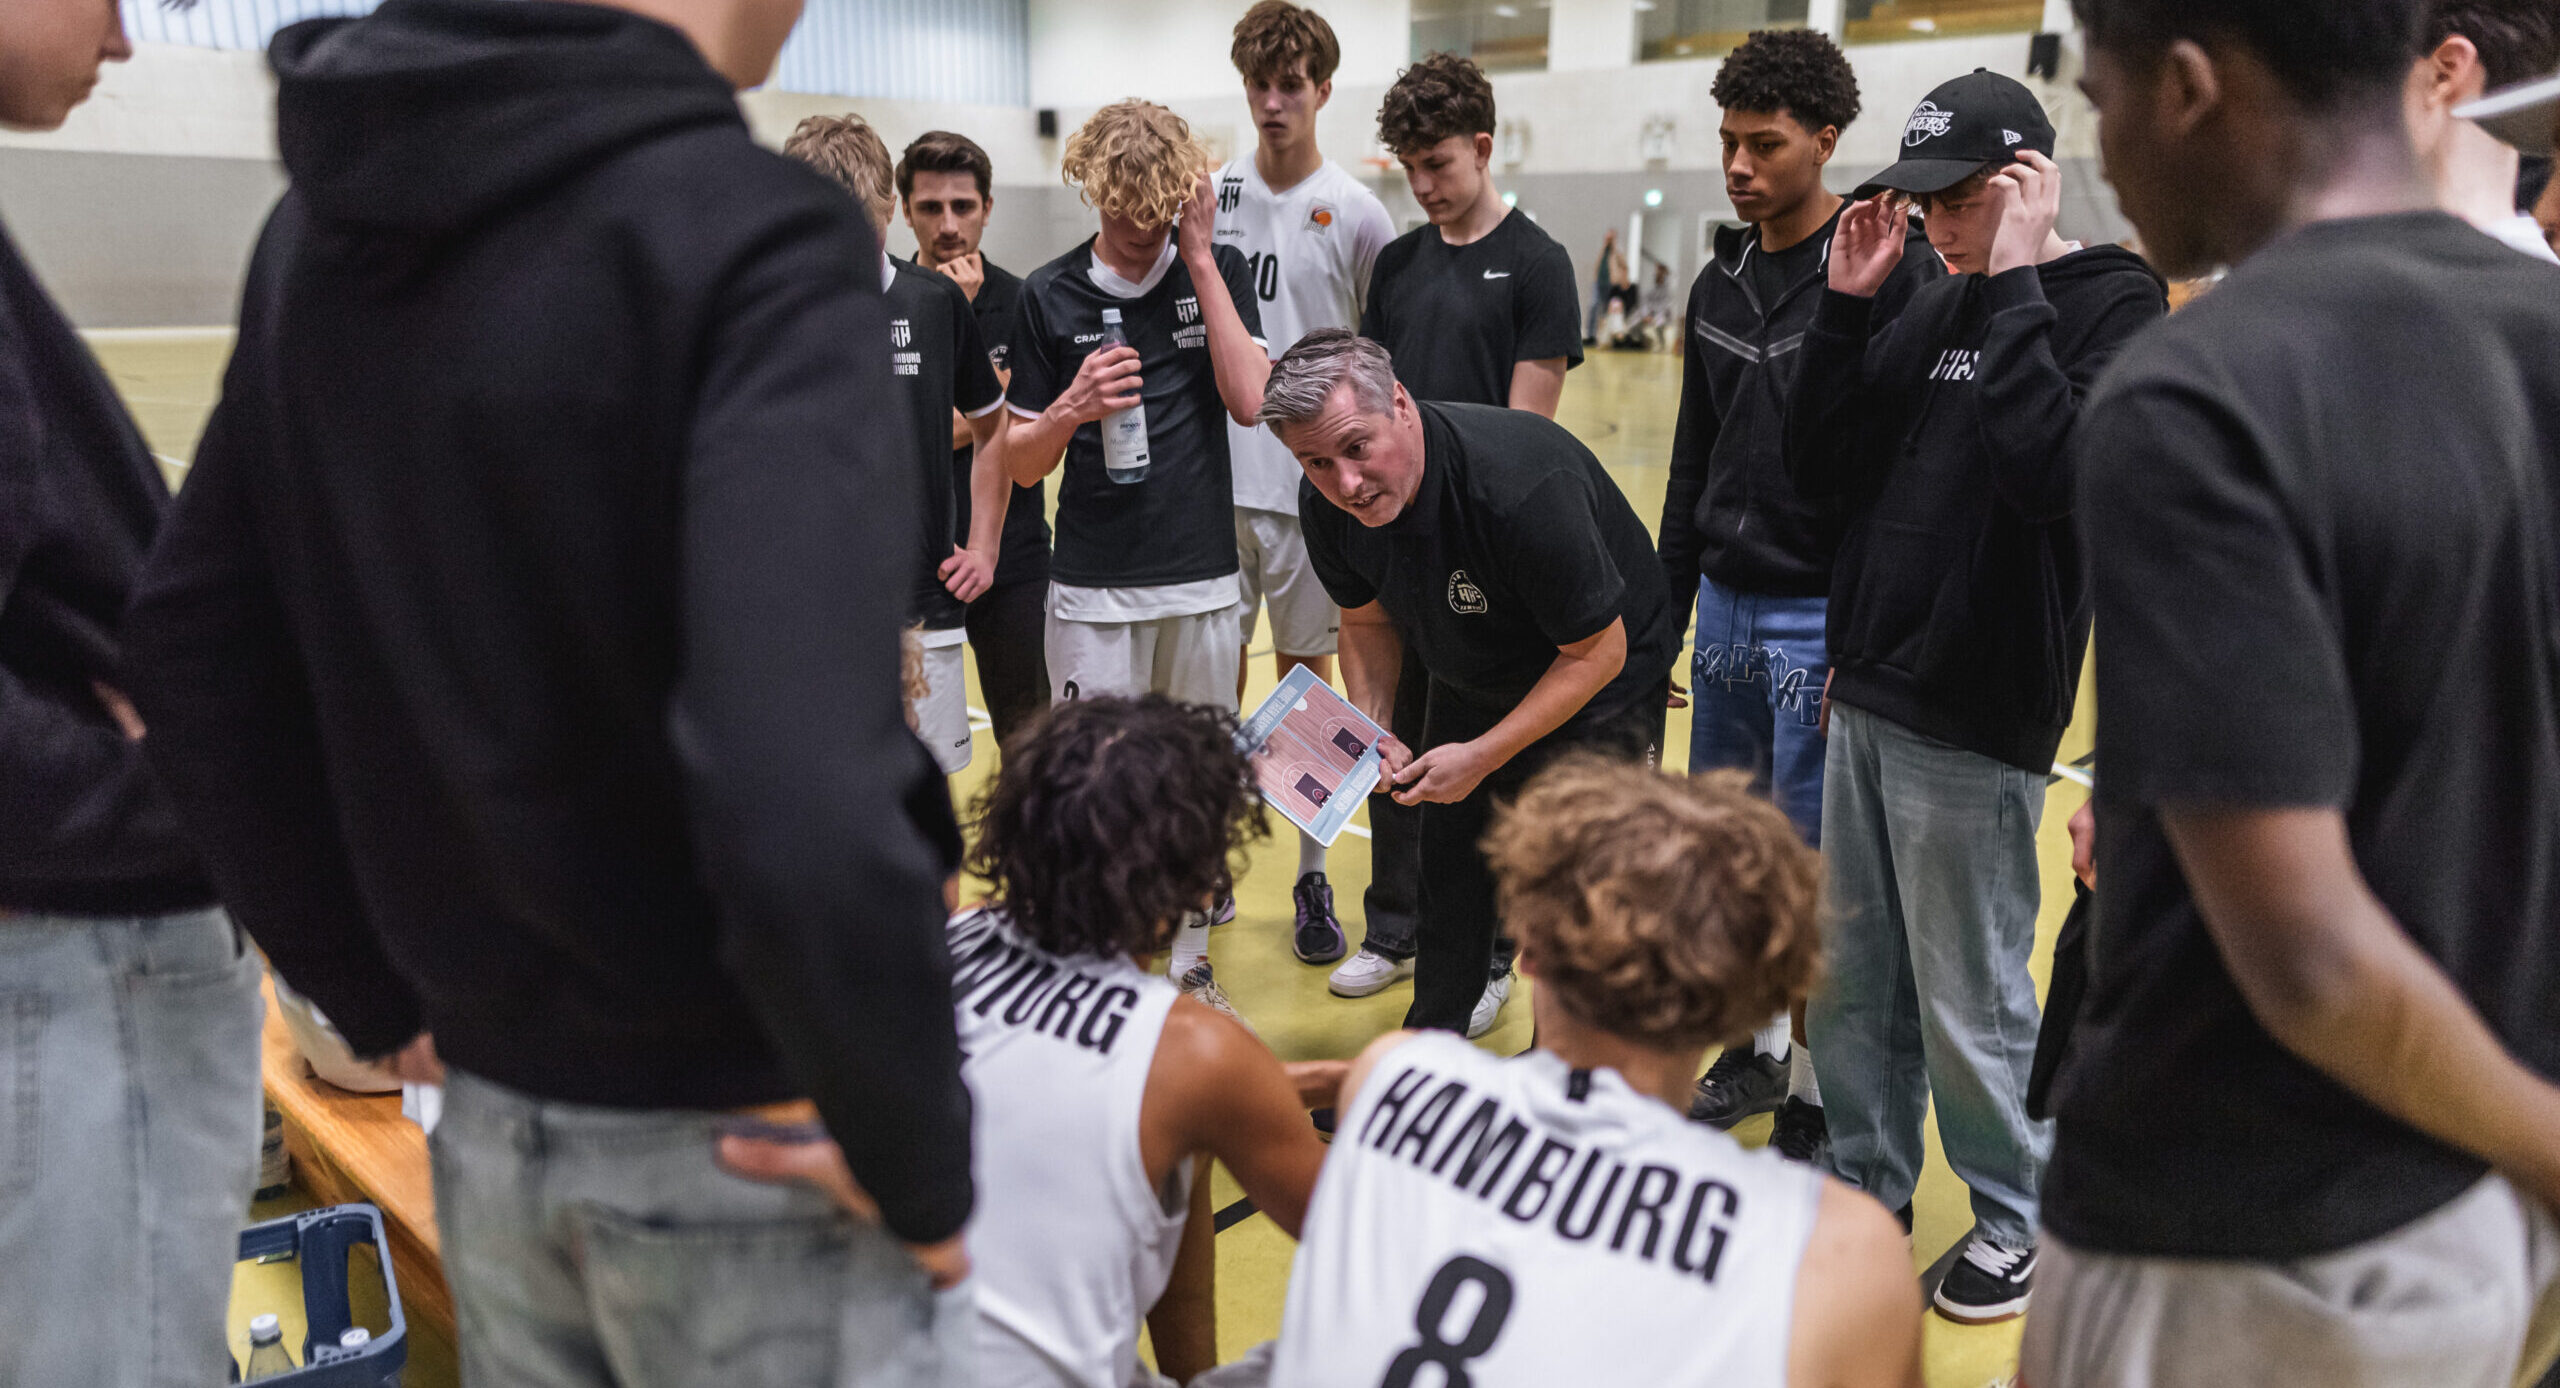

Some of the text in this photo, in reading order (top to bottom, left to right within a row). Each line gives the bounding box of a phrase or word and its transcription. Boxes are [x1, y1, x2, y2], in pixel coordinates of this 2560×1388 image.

[1248, 251, 1278, 302] 10
[893, 352, 921, 363] MBURG
[893, 364, 919, 375] OWERS
[1360, 1067, 1739, 1284] HAMBURG
[1382, 1255, 1514, 1388] 8
